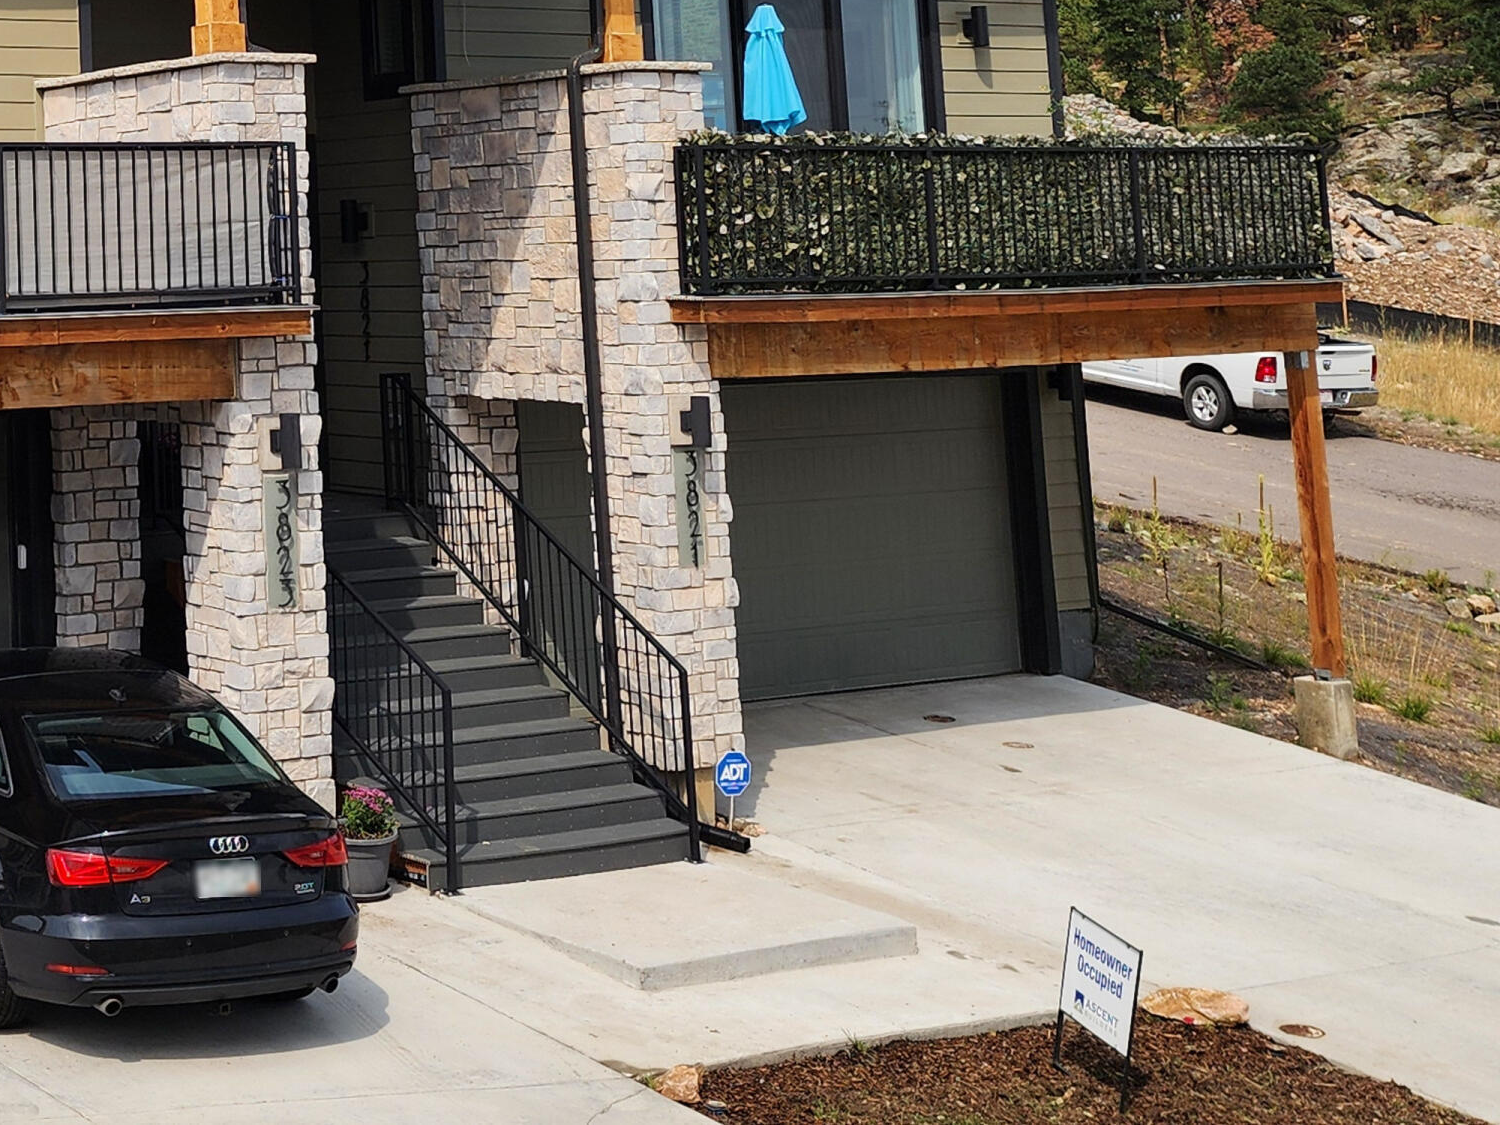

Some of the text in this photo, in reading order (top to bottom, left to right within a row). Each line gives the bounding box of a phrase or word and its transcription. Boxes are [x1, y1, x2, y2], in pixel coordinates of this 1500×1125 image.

[684, 450, 702, 570] 3821
[275, 480, 295, 607] 3823
[720, 763, 747, 781] ADT
[130, 894, 151, 904] A3
[1073, 927, 1133, 981] Homeowner
[1077, 954, 1123, 999] Occupied
[1086, 999, 1118, 1028] ASCENT
